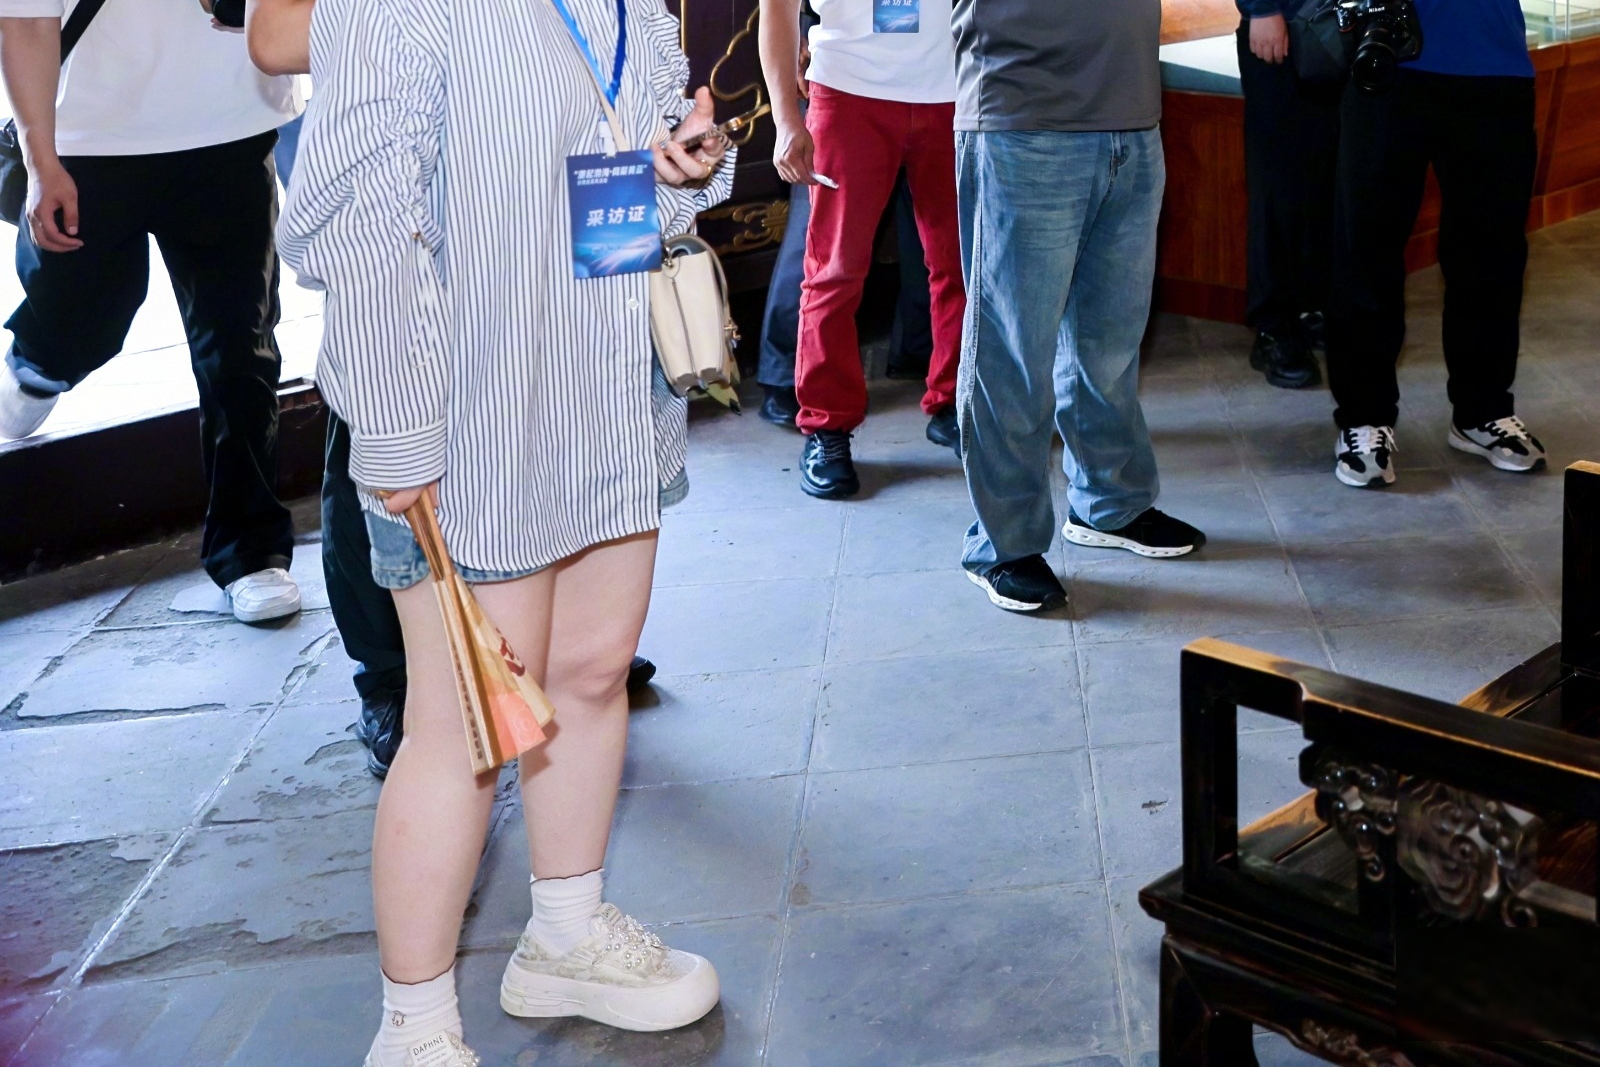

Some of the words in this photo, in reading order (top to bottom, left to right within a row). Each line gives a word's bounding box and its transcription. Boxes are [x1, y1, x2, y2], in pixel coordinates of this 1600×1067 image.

[1368, 6, 1385, 14] Nikon
[586, 205, 646, 227] 采访证
[412, 1034, 445, 1056] DAPHNE
